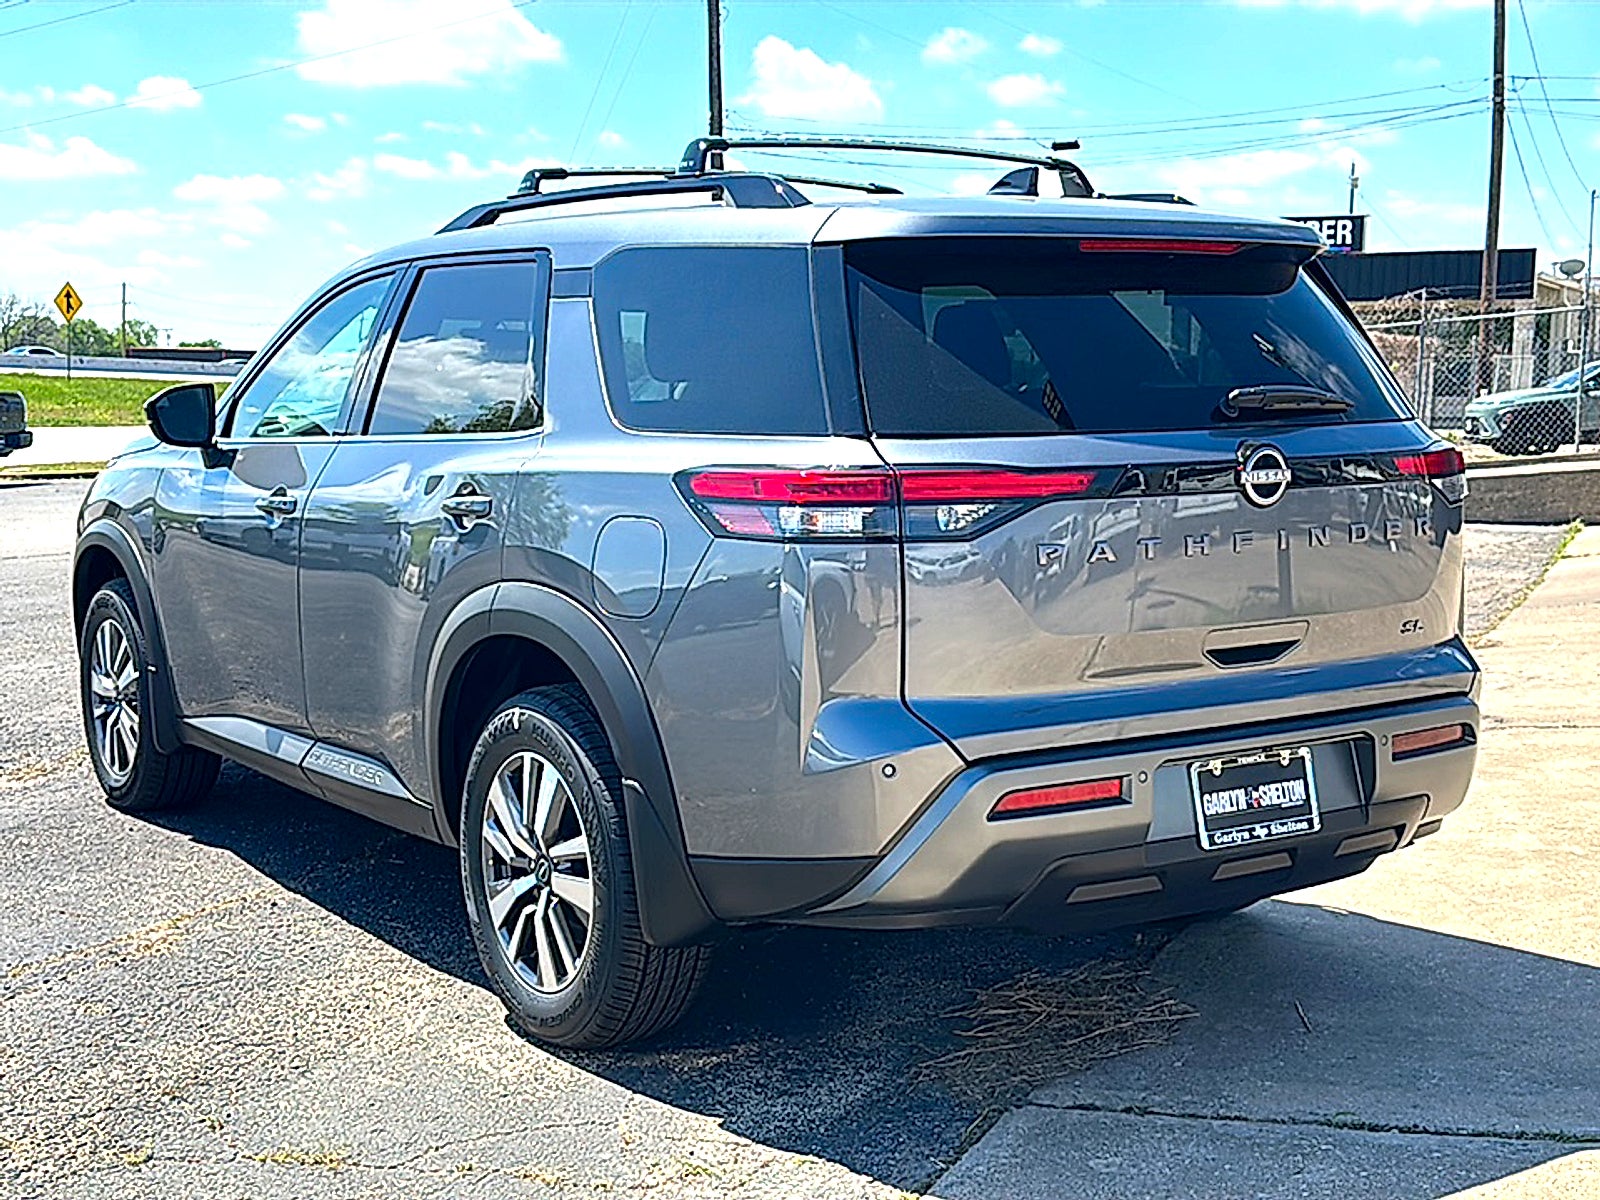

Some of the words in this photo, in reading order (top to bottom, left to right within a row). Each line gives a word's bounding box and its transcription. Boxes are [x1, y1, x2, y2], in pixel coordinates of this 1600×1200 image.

[1241, 469, 1291, 484] NISSAN
[1036, 516, 1436, 566] PATHFINDER
[1258, 778, 1307, 807] SHELTON
